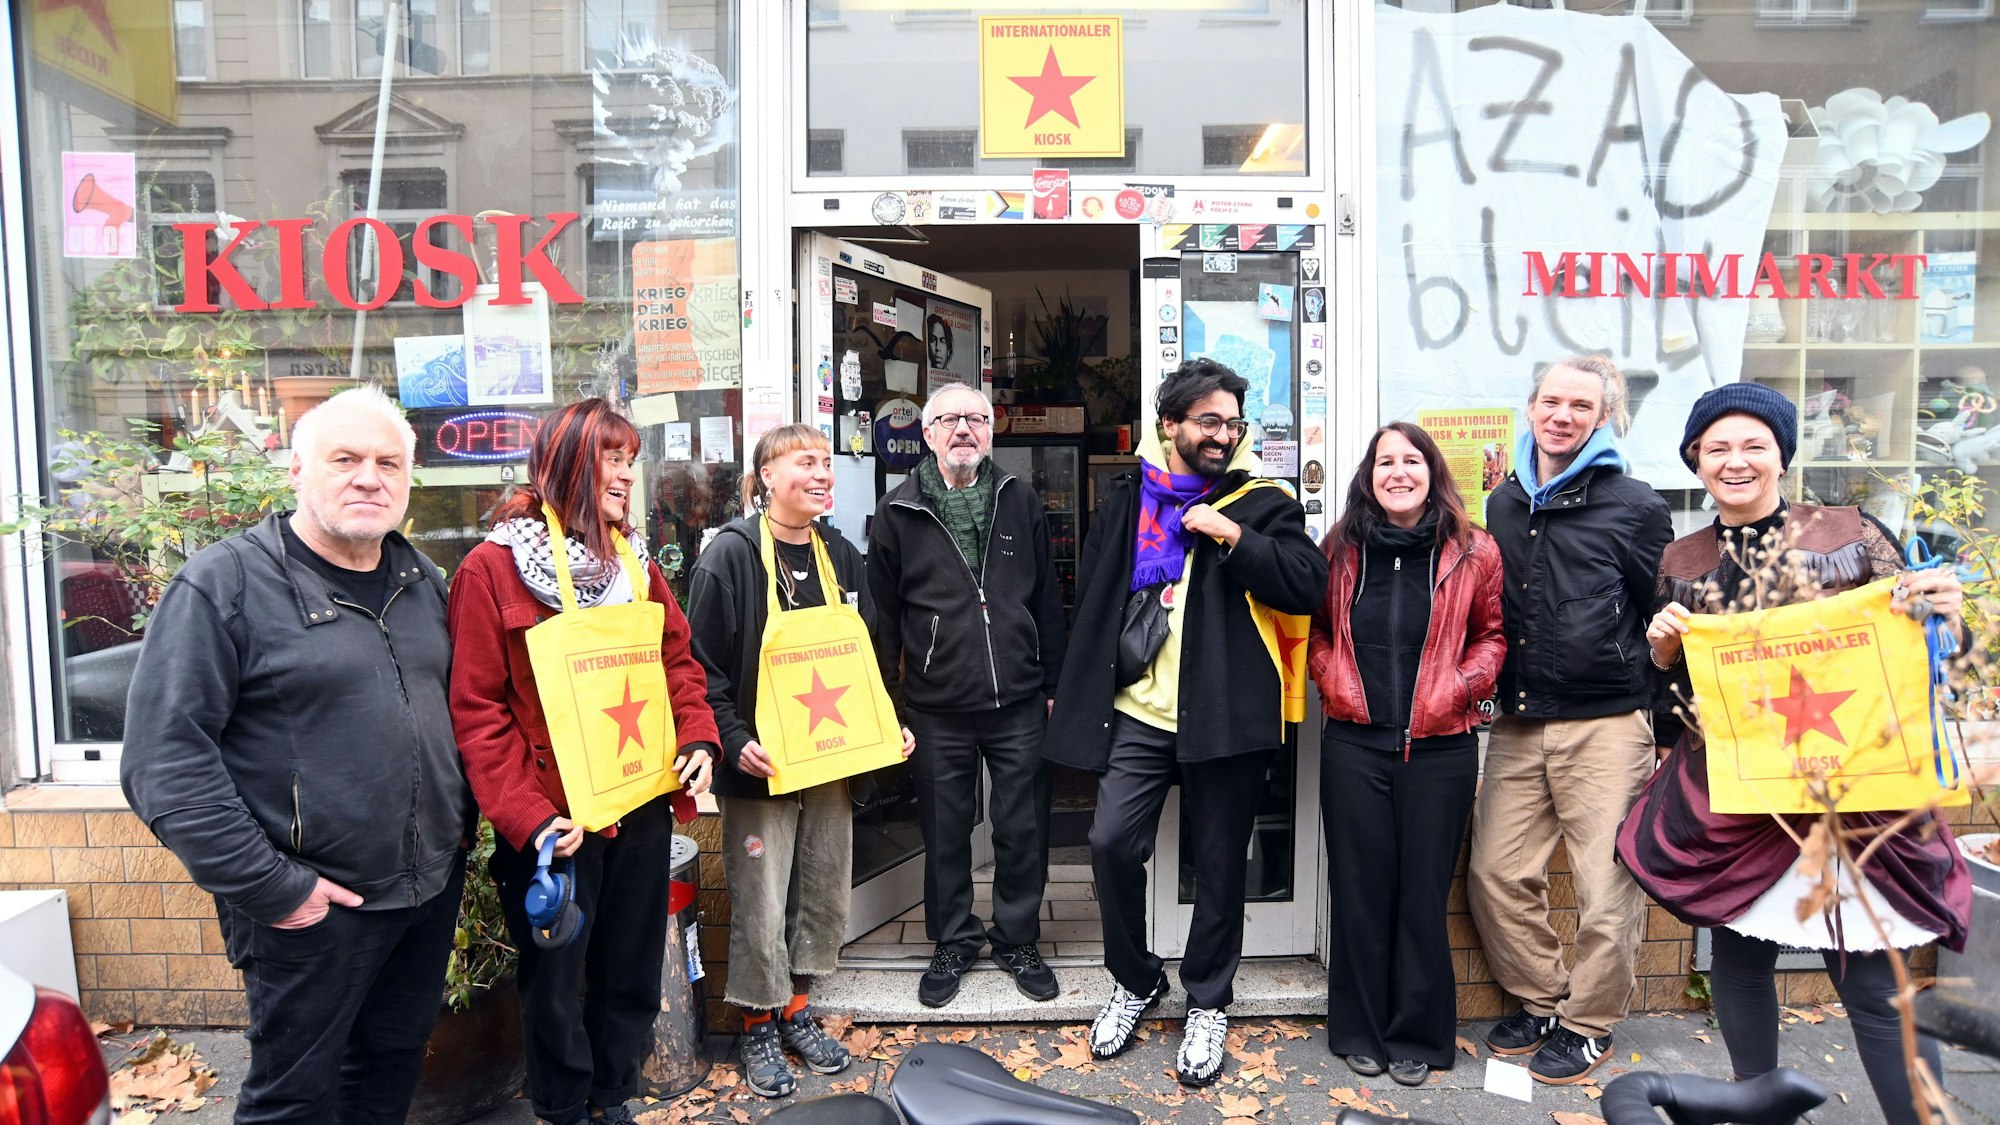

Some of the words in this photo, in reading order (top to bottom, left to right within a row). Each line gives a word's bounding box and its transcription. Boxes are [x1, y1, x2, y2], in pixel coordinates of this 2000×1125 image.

[991, 24, 1111, 39] INTERNATIONALER
[1033, 133, 1072, 146] KIOSK
[600, 197, 666, 213] Niemand
[676, 197, 701, 210] hat
[710, 196, 736, 210] das
[602, 217, 638, 231] Recht
[645, 219, 661, 229] zu
[668, 215, 734, 231] gehorchen
[172, 212, 584, 313] KIOSK
[1933, 265, 1969, 273] CRUSHER
[1521, 250, 1927, 300] MINIMARKT
[637, 287, 687, 301] KRIEG
[638, 303, 674, 316] DEM
[639, 318, 688, 331] KRIEG
[874, 314, 897, 325] RASSISMUS
[893, 407, 913, 417] ortel
[1423, 415, 1509, 428] INTERNATIONALER
[436, 418, 541, 453] OPEN
[1428, 430, 1452, 440] IOSK
[1471, 429, 1507, 439] BLEIBT!
[887, 438, 921, 455] OPEN
[770, 642, 859, 667] INTERNATIONALER
[1720, 631, 1871, 665] INTERNATIONALER
[573, 649, 661, 674] INTERNATIONALER
[815, 735, 847, 752] KIOSK
[622, 759, 643, 778] KIOSK
